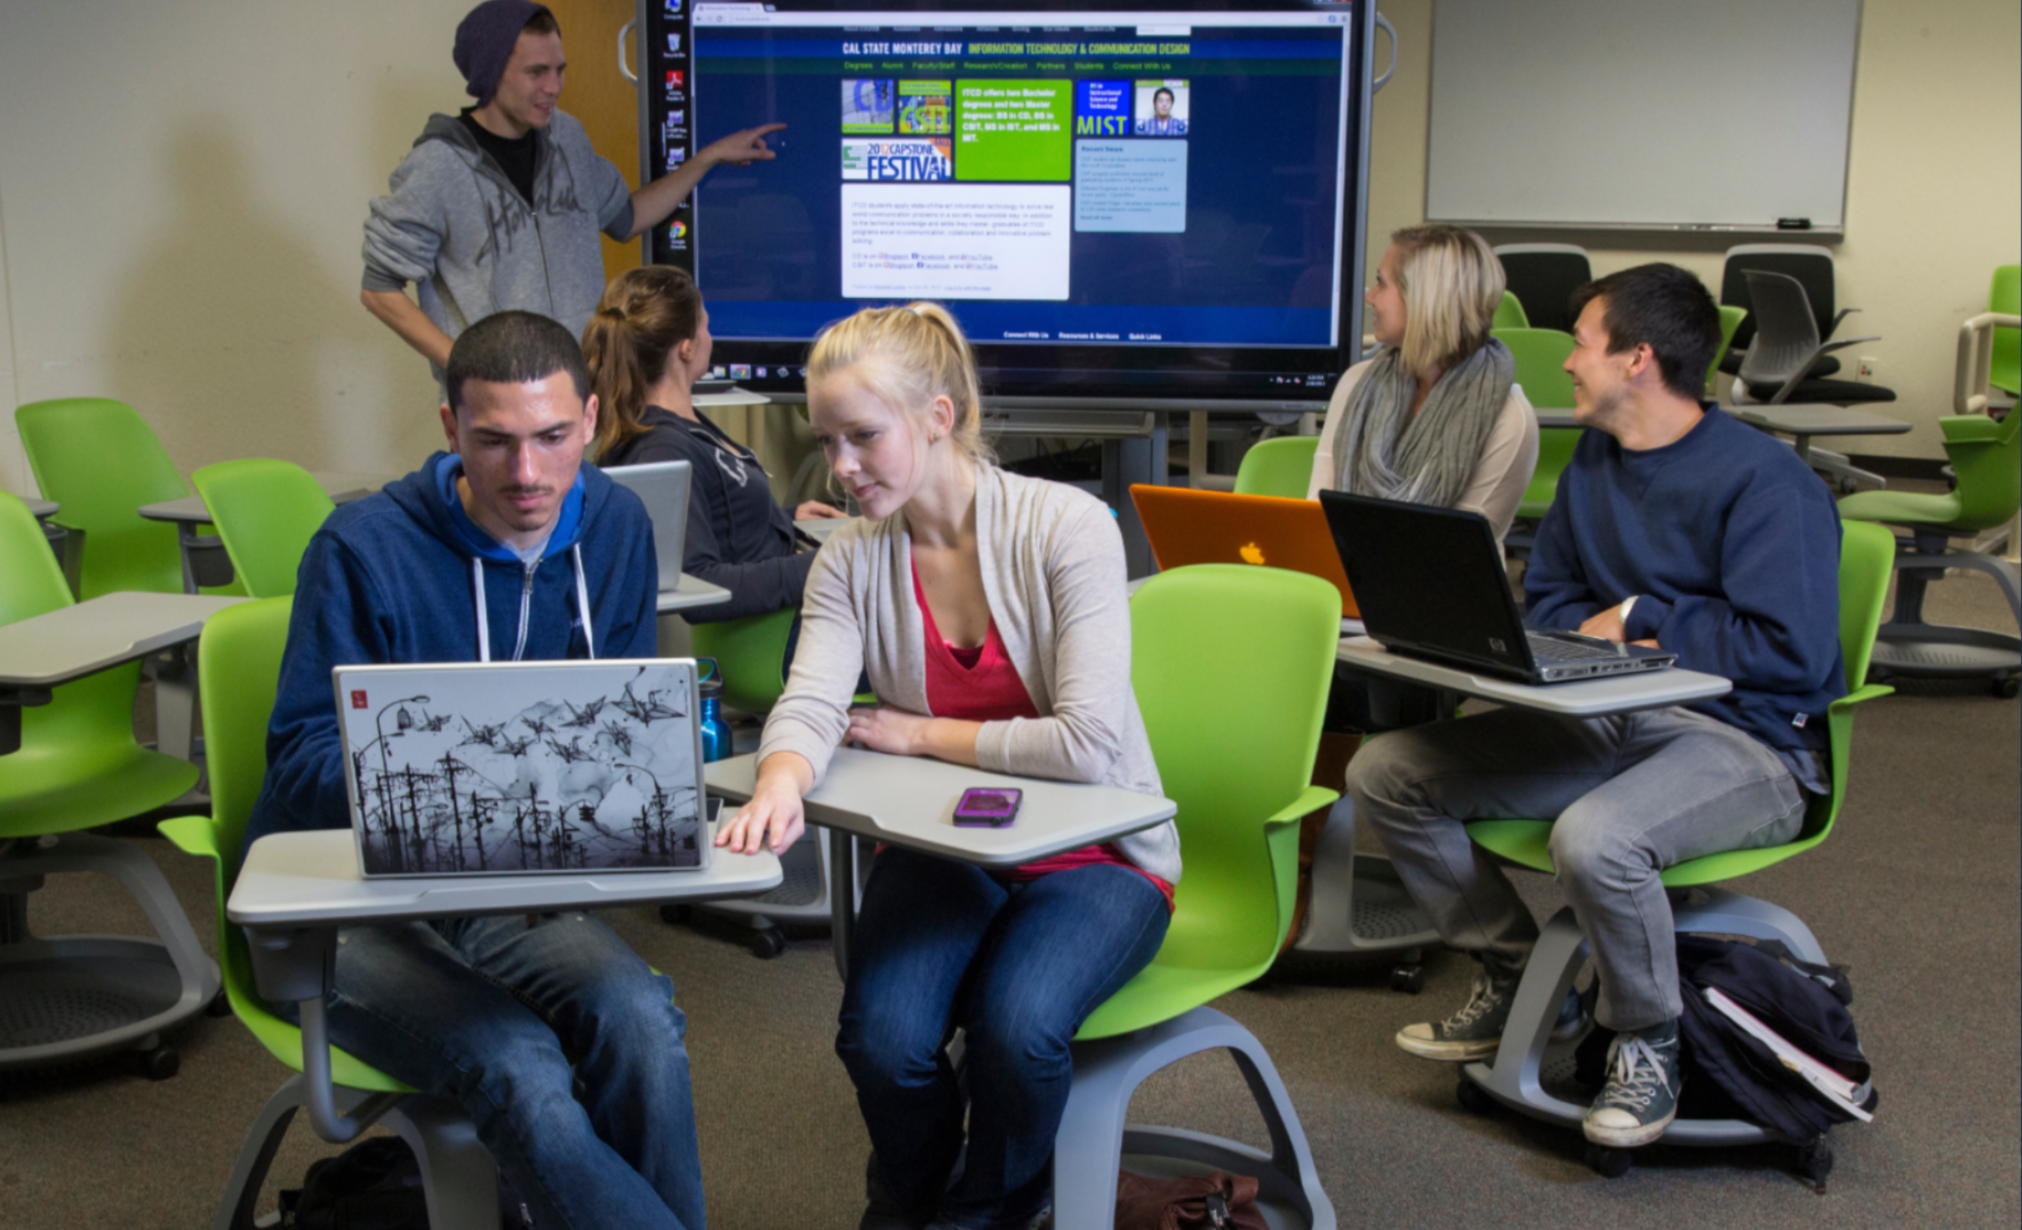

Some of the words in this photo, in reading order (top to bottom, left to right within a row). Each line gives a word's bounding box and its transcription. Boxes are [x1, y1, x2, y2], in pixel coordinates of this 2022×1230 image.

[843, 42, 861, 55] CAL
[863, 42, 890, 55] STATE
[892, 42, 942, 55] MONTEREY
[944, 42, 963, 55] BAY
[968, 42, 1024, 55] INFORMATION
[1026, 42, 1078, 55] TECHNOLOGY
[1079, 42, 1087, 55] &
[1088, 42, 1157, 55] COMMUNICATION
[1159, 42, 1190, 55] DESIGN
[844, 62, 873, 71] Degrees
[912, 62, 956, 71] Faculty/Staff
[963, 62, 1028, 70] Research/Creation
[1036, 62, 1066, 70] Partners
[1075, 62, 1104, 70] Students
[1113, 62, 1142, 70] Connect
[1144, 62, 1160, 70] With
[1161, 62, 1171, 70] Us
[962, 89, 981, 97] ITCD
[983, 89, 1005, 97] offers
[1006, 89, 1021, 97] two
[1022, 89, 1056, 97] Bachelor
[962, 100, 992, 110] degrees
[994, 100, 1008, 109] and
[1009, 100, 1024, 109] two
[1025, 100, 1051, 109] Master
[1008, 111, 1017, 120] in
[1046, 111, 1054, 120] in
[998, 122, 1006, 131] in
[1023, 122, 1038, 131] and
[1052, 122, 1060, 131] in
[1077, 116, 1127, 135] MIST
[1081, 145, 1104, 153] Recent
[1105, 145, 1124, 153] News
[867, 156, 951, 180] FESTIVAL
[1003, 331, 1027, 339] Connect
[1027, 331, 1039, 339] With
[1040, 331, 1049, 339] Us
[1058, 332, 1089, 340] Resources
[1095, 332, 1119, 340] Services
[1129, 333, 1145, 341] Quick
[1146, 333, 1162, 341] Links
